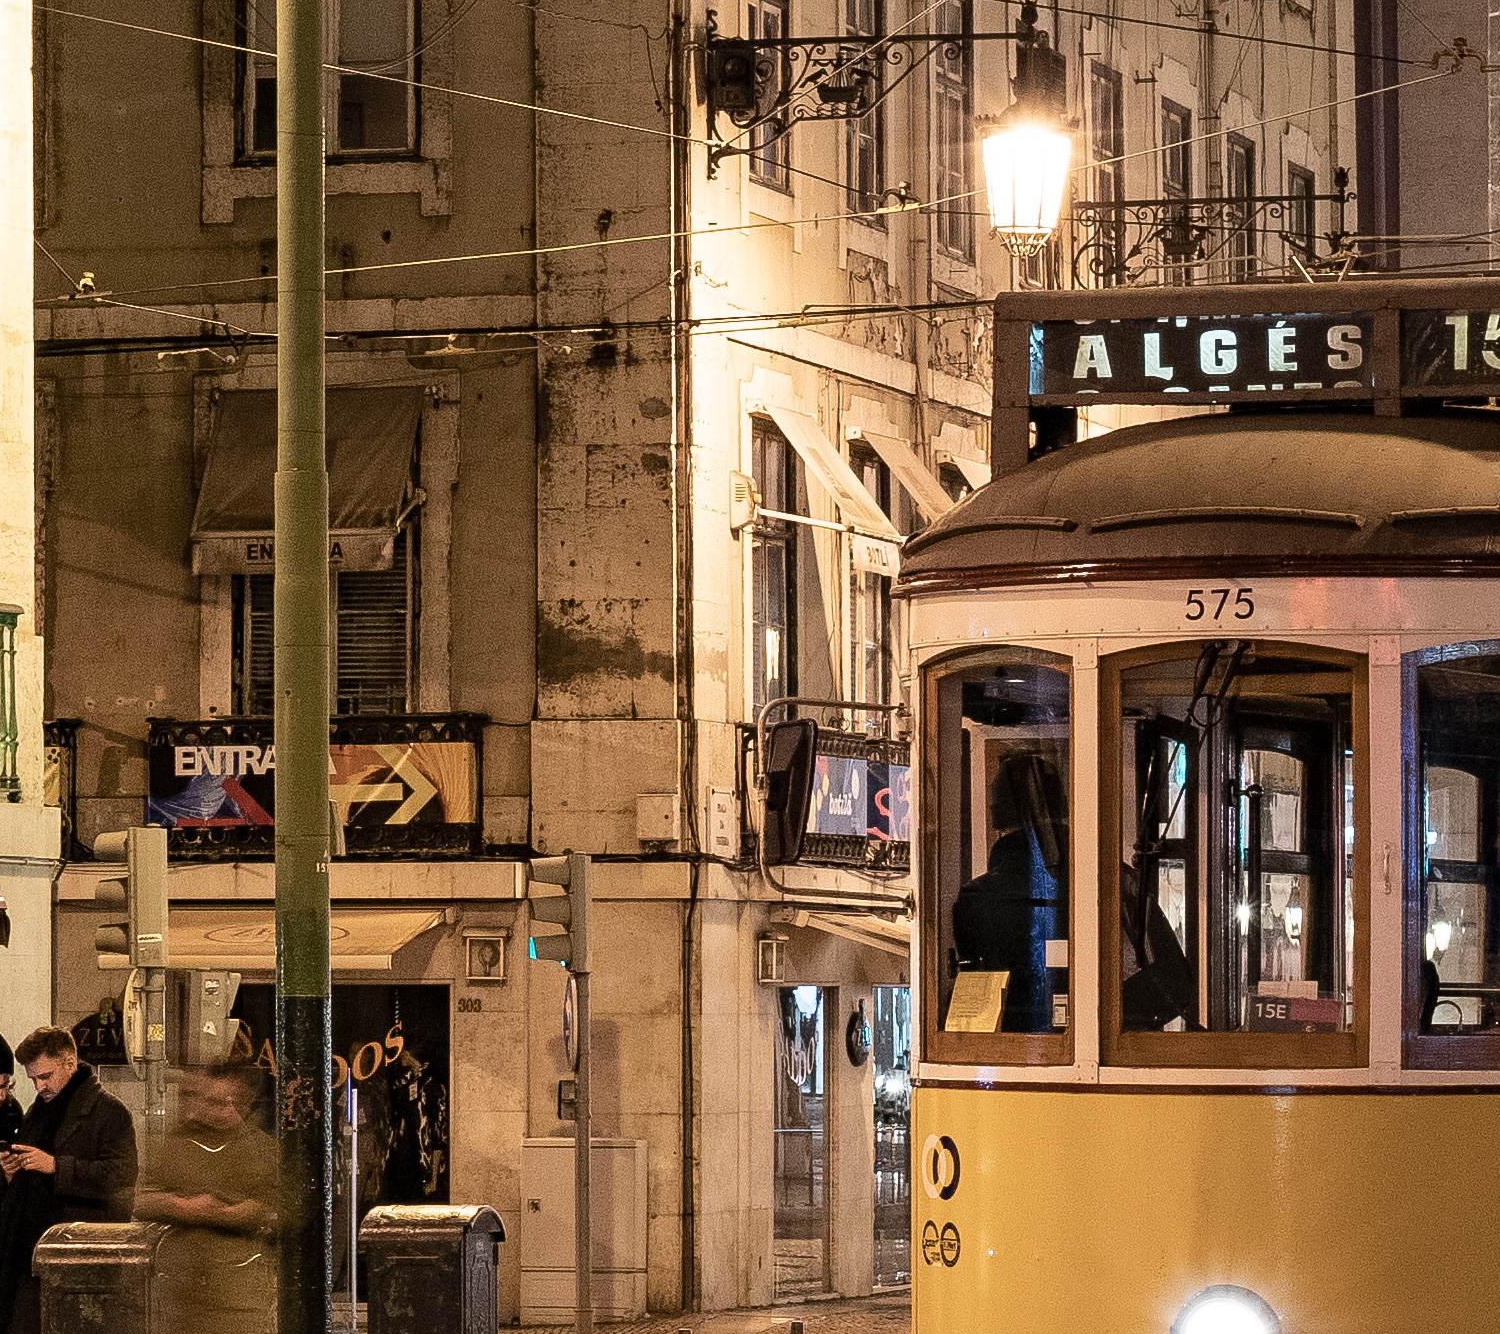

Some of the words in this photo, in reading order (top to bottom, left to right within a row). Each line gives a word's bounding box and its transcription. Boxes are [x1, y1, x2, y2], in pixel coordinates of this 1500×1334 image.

[1073, 320, 1363, 380] ALGÉS
[1185, 587, 1255, 621] 575
[175, 745, 338, 779] ENTRA
[457, 997, 483, 1013] 303
[1256, 1002, 1287, 1020] 15E
